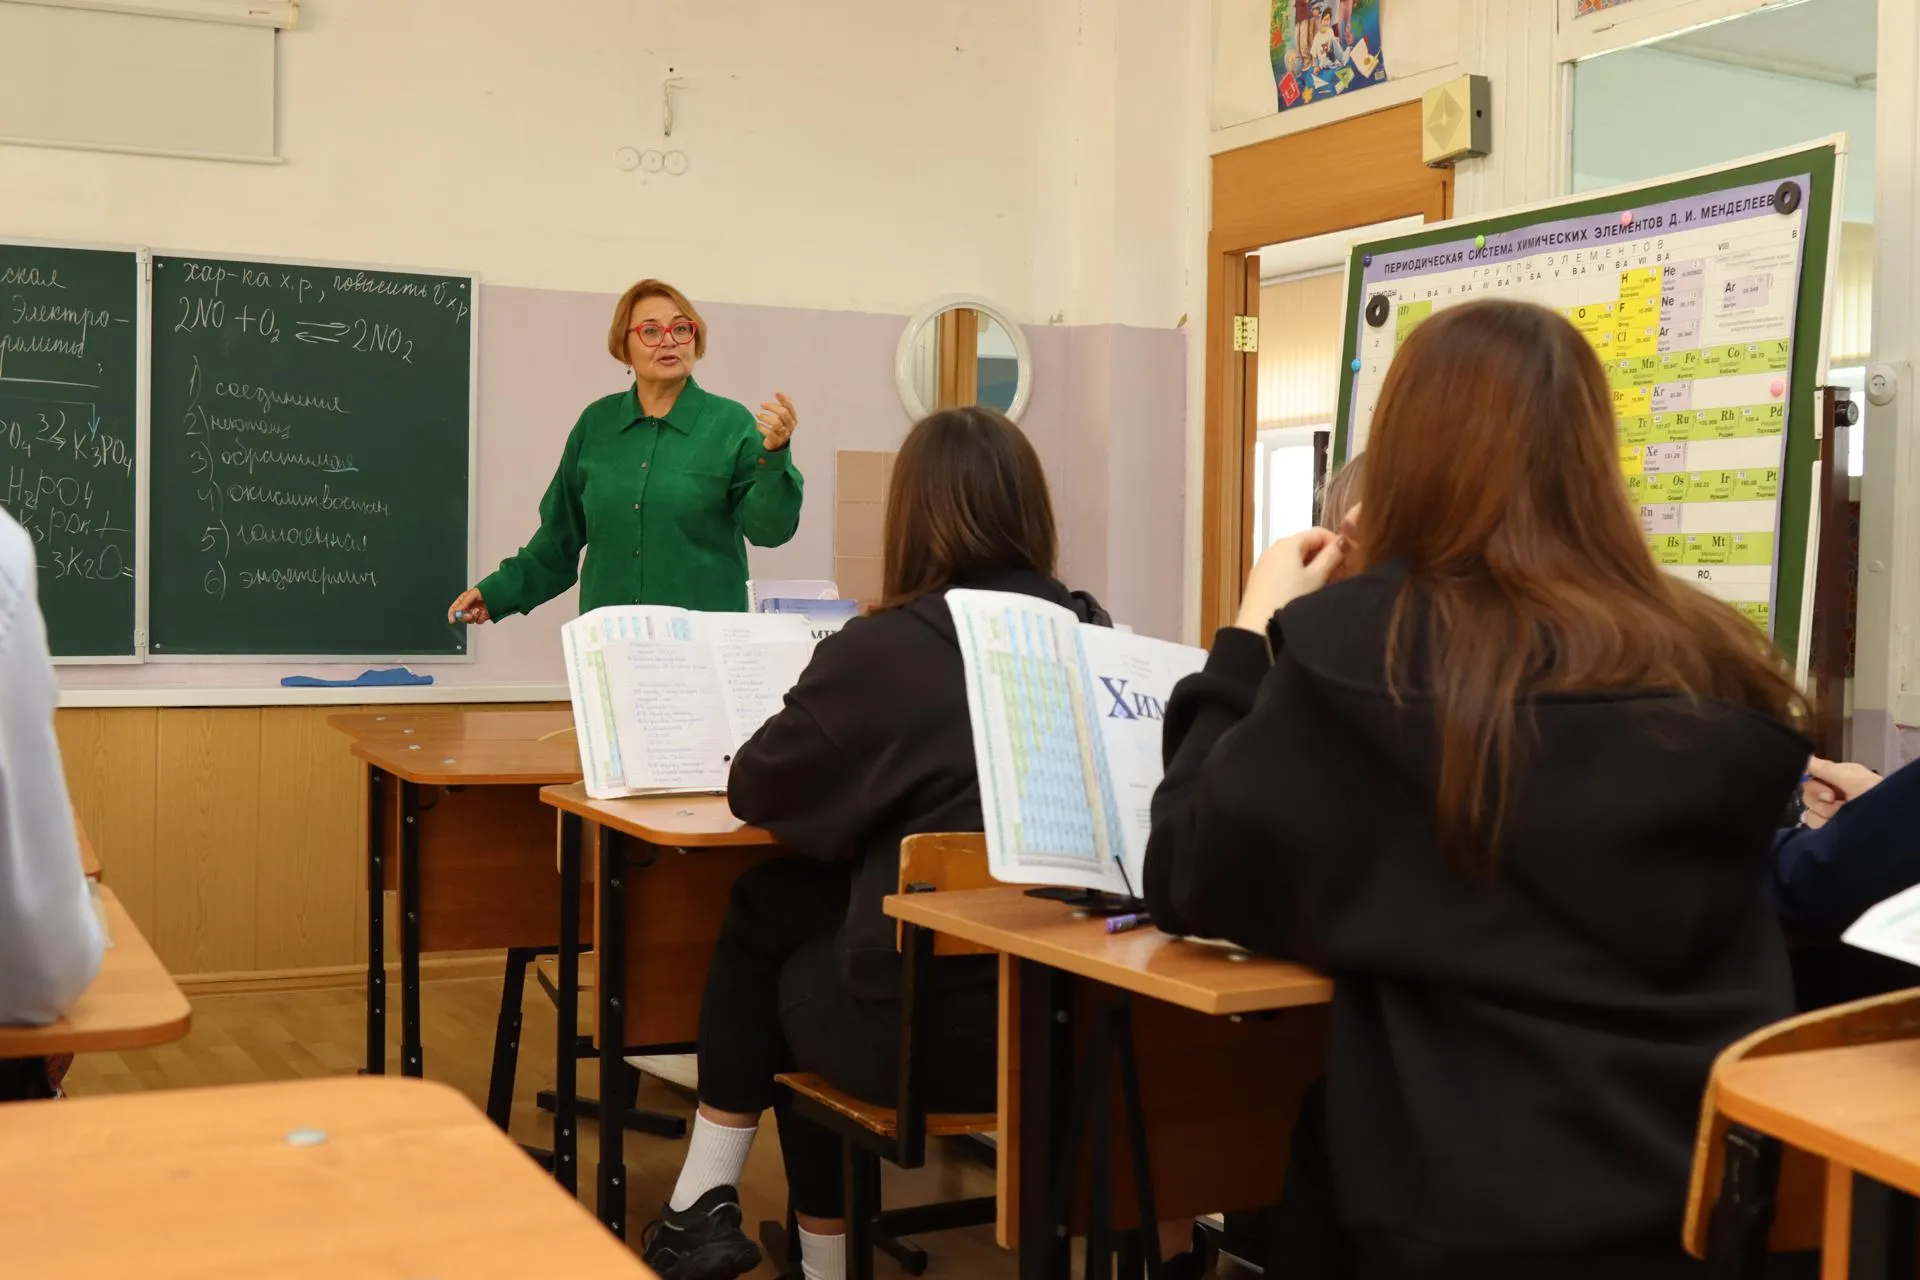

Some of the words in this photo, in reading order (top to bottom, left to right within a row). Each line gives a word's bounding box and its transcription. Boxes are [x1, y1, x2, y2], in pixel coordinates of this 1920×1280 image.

[1384, 251, 1463, 275] ПЕРИОДИЧЕСКАЯ
[1468, 243, 1513, 261] СИСТЕМА
[1517, 229, 1587, 251] ХИМИЧЕСКИХ
[1594, 216, 1663, 239] ЭЛЕМЕНТОВ
[1668, 213, 1681, 229] Д.
[1685, 209, 1697, 223] И.
[1701, 193, 1775, 219] МЕНДЕЛЕЕВ
[1663, 265, 1676, 277] He
[0, 267, 67, 289] ская
[1621, 273, 1629, 284] H
[1724, 281, 1737, 293] Ar
[1661, 295, 1675, 307] Ne
[1578, 308, 1586, 319] O
[1618, 302, 1626, 313] F
[1617, 331, 1627, 343] Cl
[1658, 326, 1670, 337] Ar
[352, 318, 412, 365] 2NO2
[1777, 341, 1788, 354] Ni
[1684, 353, 1696, 365] Fe
[1728, 347, 1741, 359] Co
[1641, 358, 1655, 370] Mn
[1653, 385, 1666, 397] Kr
[1720, 410, 1736, 422] Rh
[1769, 406, 1784, 418] Pd
[1676, 413, 1690, 425] Ru
[1646, 445, 1659, 458] Xe
[1628, 477, 1641, 488] Re
[1673, 474, 1685, 486] Os
[1721, 473, 1732, 484] Ir
[1667, 536, 1679, 548] Hs
[1712, 535, 1726, 547] Mt
[1098, 675, 1166, 721] Хим
